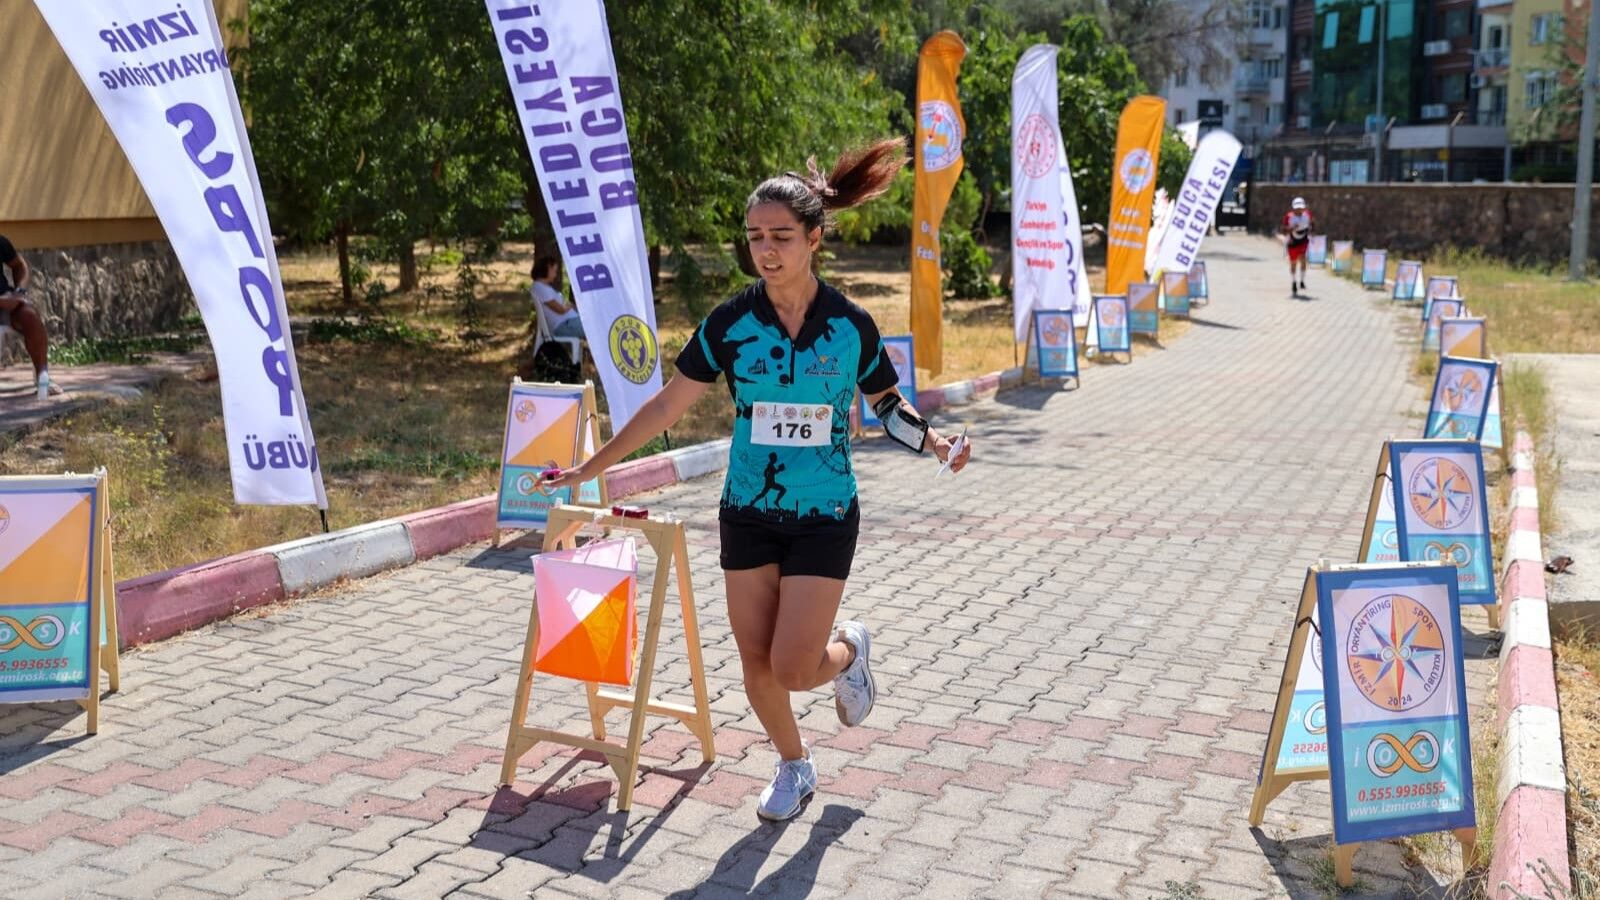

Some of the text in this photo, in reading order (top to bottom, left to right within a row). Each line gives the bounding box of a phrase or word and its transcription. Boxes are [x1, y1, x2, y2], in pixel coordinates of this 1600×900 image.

[1172, 178, 1203, 230] BUCA
[773, 422, 812, 440] 176
[1412, 607, 1433, 632] SPOR
[1387, 694, 1412, 706] 2024
[1357, 781, 1448, 803] 0.555.9936555
